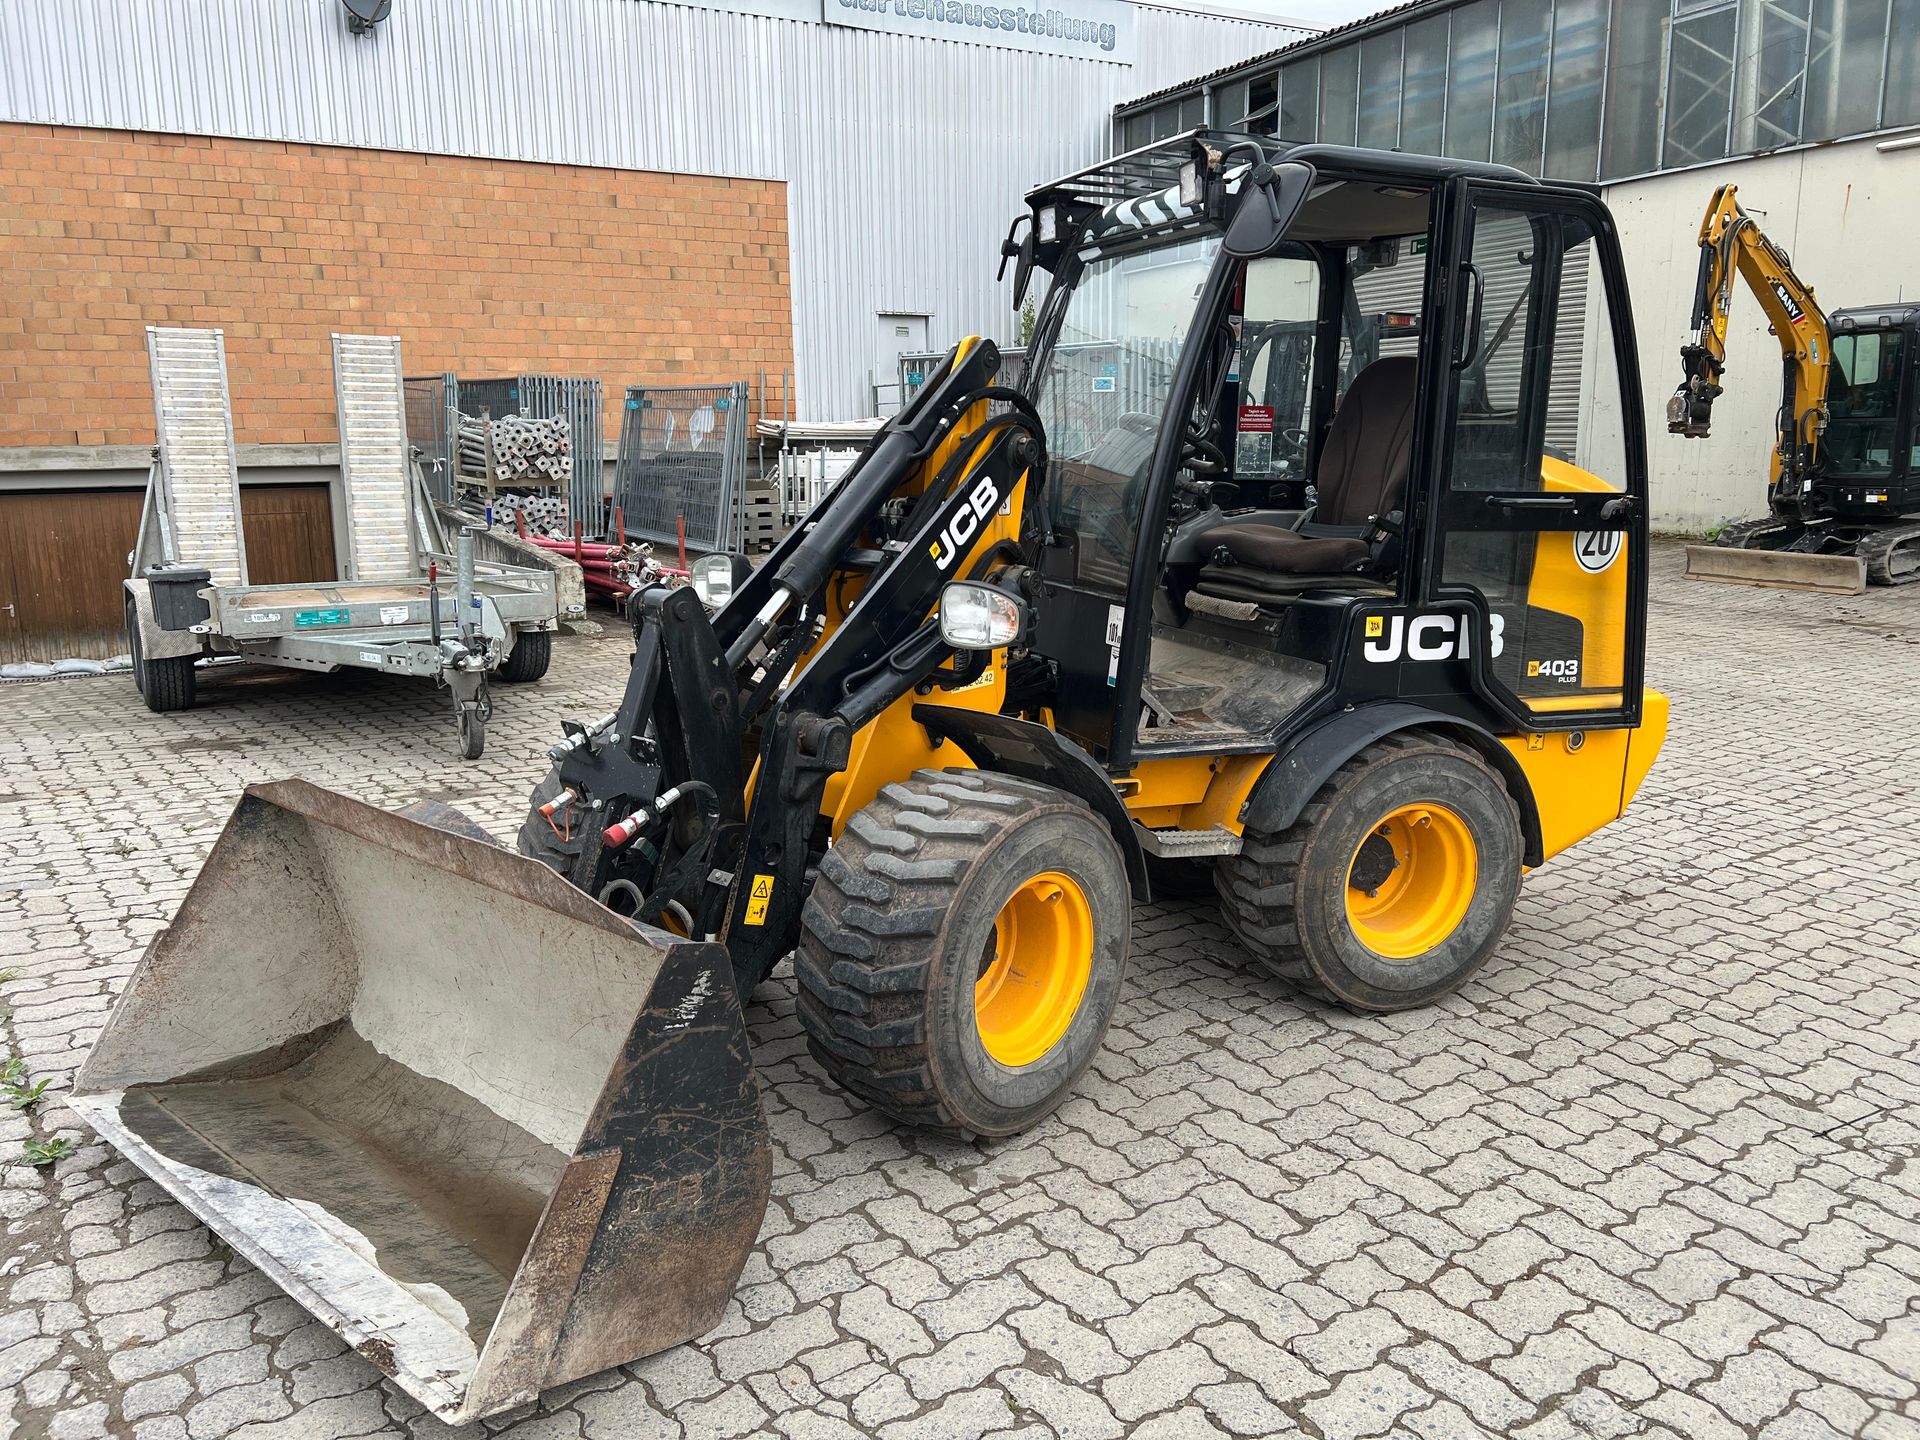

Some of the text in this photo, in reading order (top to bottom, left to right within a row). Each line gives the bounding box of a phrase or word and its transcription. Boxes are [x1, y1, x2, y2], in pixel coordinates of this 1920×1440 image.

[840, 0, 1113, 51] artenausstellung
[1776, 285, 1799, 317] SANY
[935, 475, 999, 571] JCB
[1581, 530, 1613, 557] 20
[1538, 659, 1578, 676] 403
[1558, 676, 1577, 684] PLUS
